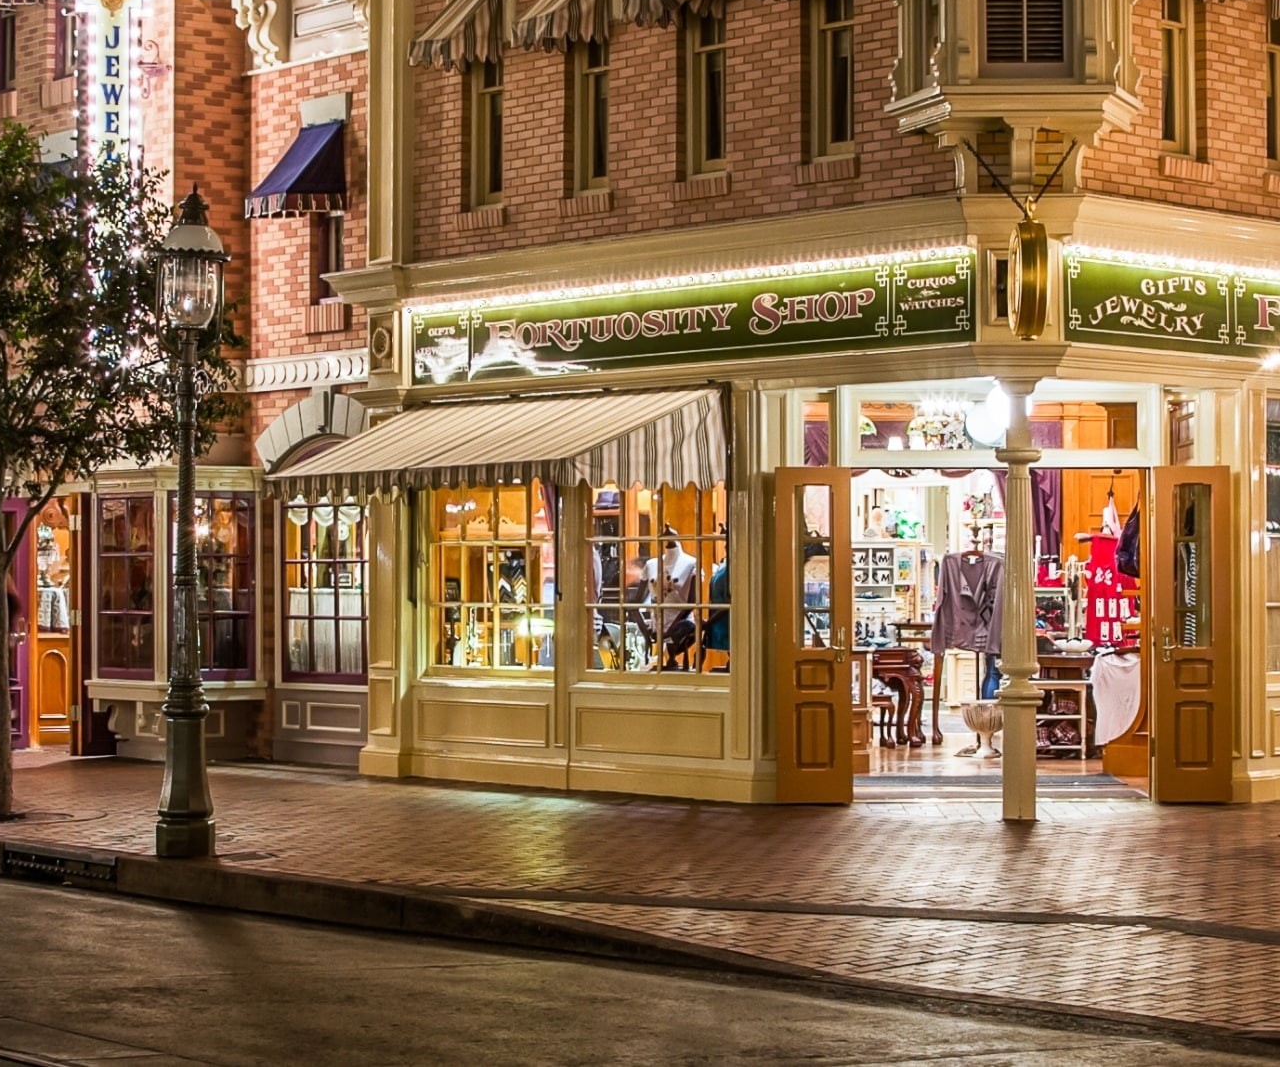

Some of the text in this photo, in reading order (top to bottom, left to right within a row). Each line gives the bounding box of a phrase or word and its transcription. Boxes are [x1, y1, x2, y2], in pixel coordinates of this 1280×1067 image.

[906, 275, 957, 290] CURIOS
[1140, 277, 1207, 297] GIFTS
[898, 295, 966, 312] WATCHES
[486, 288, 876, 352] FORTUOSITY SHOP
[1088, 295, 1205, 335] JEWELRY
